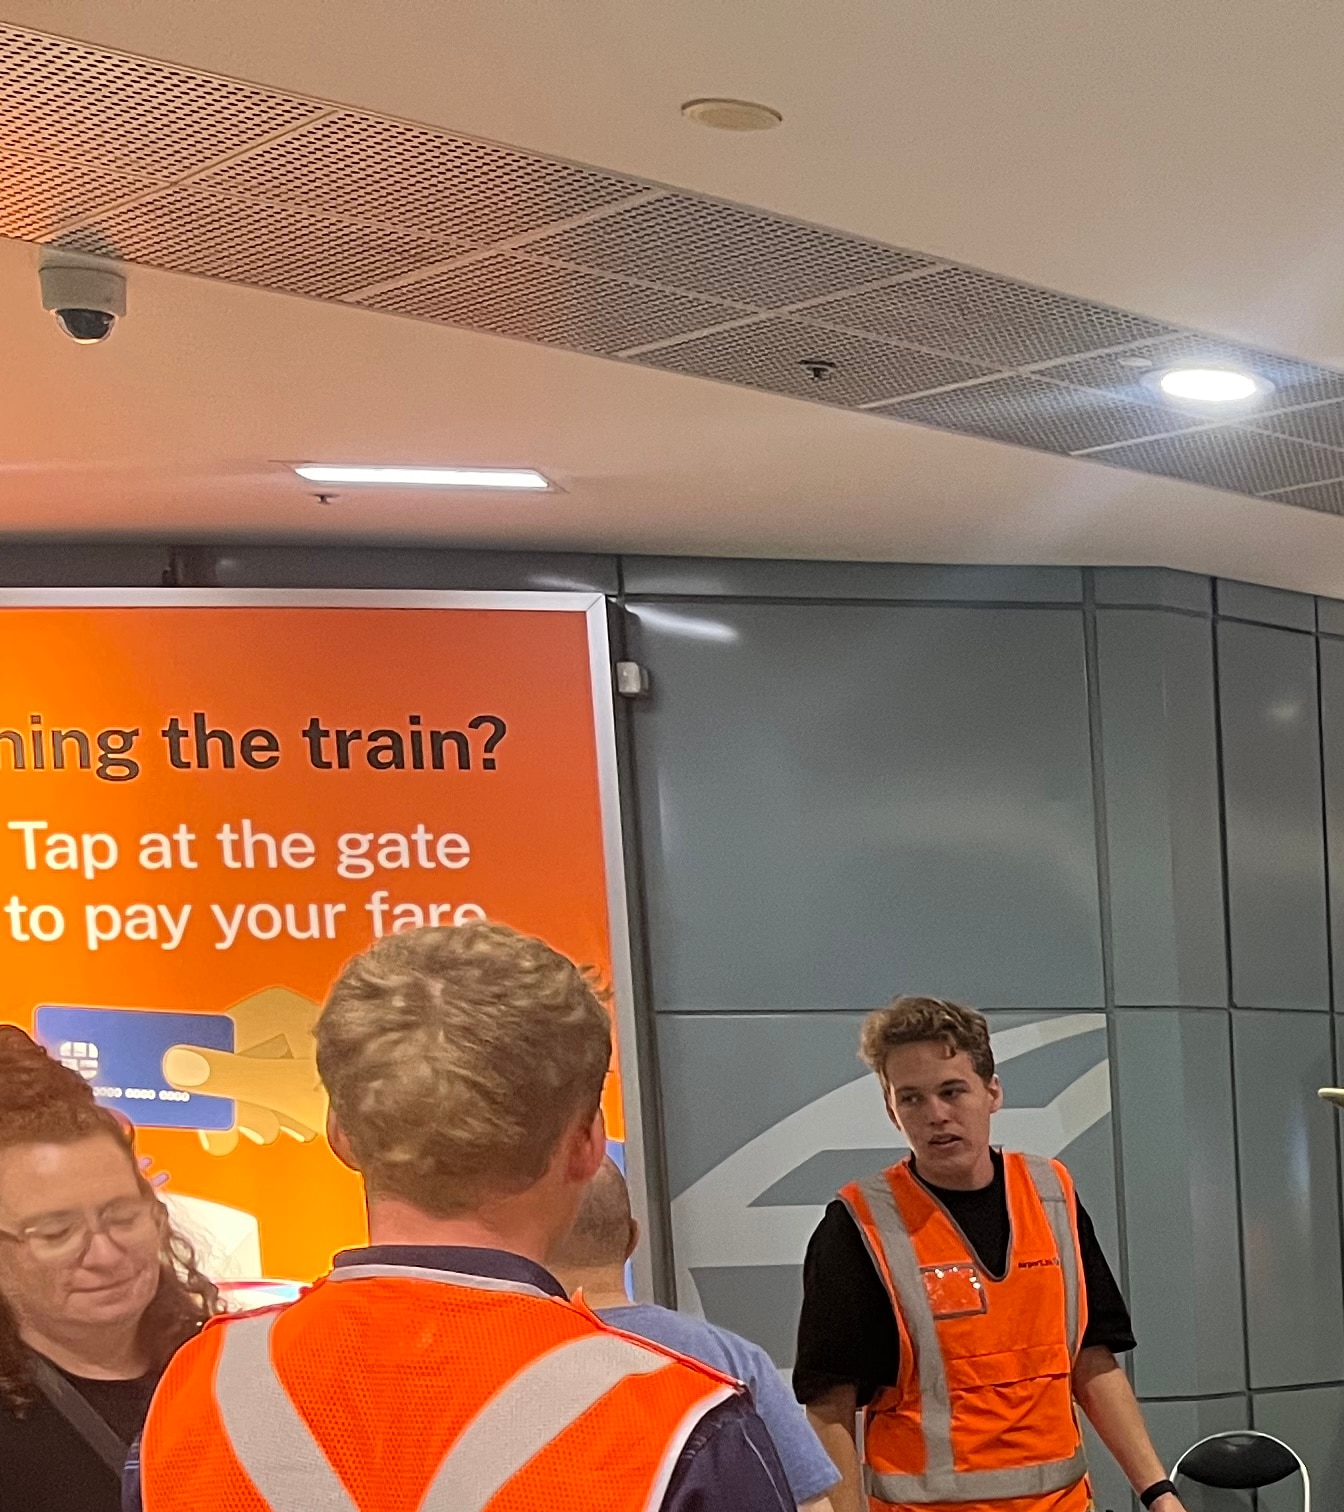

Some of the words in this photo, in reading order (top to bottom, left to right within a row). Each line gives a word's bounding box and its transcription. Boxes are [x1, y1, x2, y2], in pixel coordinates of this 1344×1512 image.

[162, 713, 281, 770] the
[302, 715, 507, 771] train?
[8, 820, 118, 878] Tap
[138, 823, 196, 869] at
[216, 819, 316, 869] the
[337, 823, 471, 879] gate
[4, 895, 65, 942] to
[86, 900, 192, 950] pay
[211, 901, 347, 948] your
